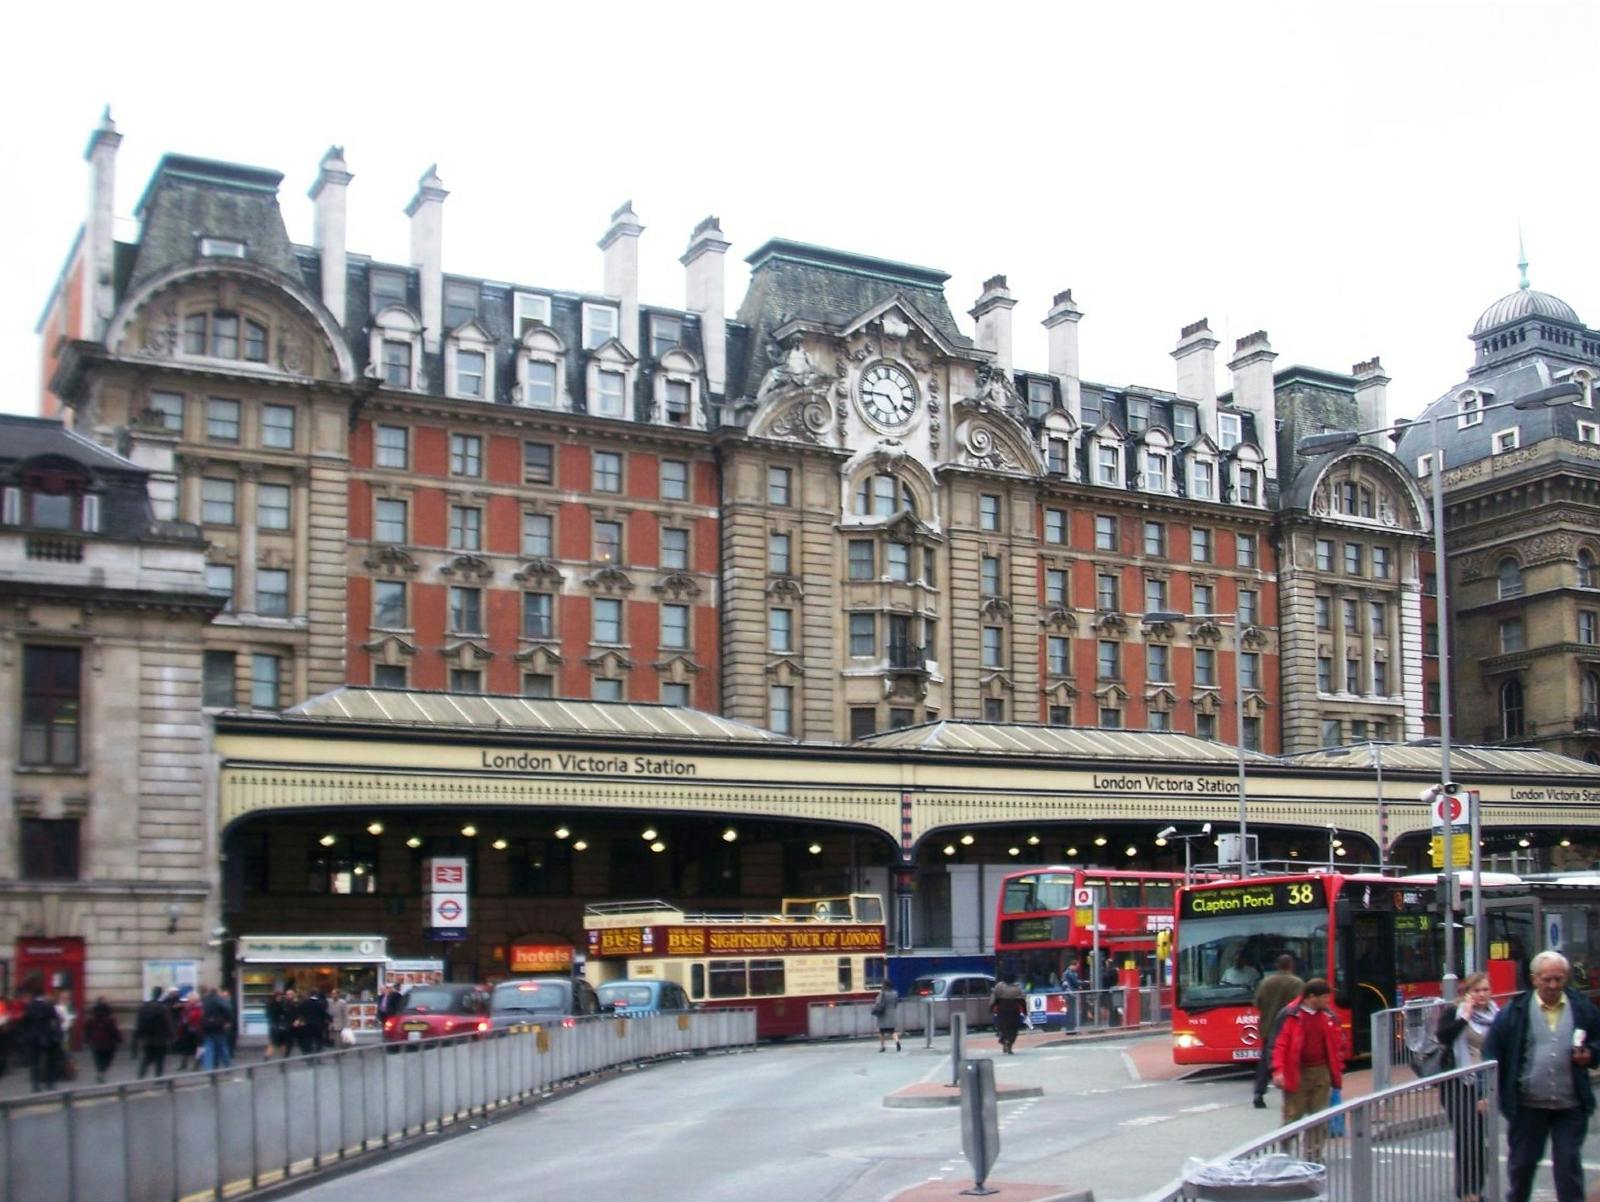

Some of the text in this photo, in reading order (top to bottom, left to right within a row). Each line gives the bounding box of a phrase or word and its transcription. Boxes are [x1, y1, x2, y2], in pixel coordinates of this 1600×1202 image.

[482, 751, 696, 775] London Victoria Station
[1093, 775, 1240, 793] London Victoria Station
[1510, 787, 1544, 800] London
[1546, 788, 1580, 801] Victoria
[1192, 896, 1240, 914] Clapton
[1242, 893, 1274, 907] Pond
[1287, 884, 1314, 905] 38
[601, 934, 641, 947] BUS
[668, 934, 704, 946] BUS
[709, 932, 881, 949] SIGHTSEEING TOUR OF LONDON
[516, 949, 570, 962] hotels
